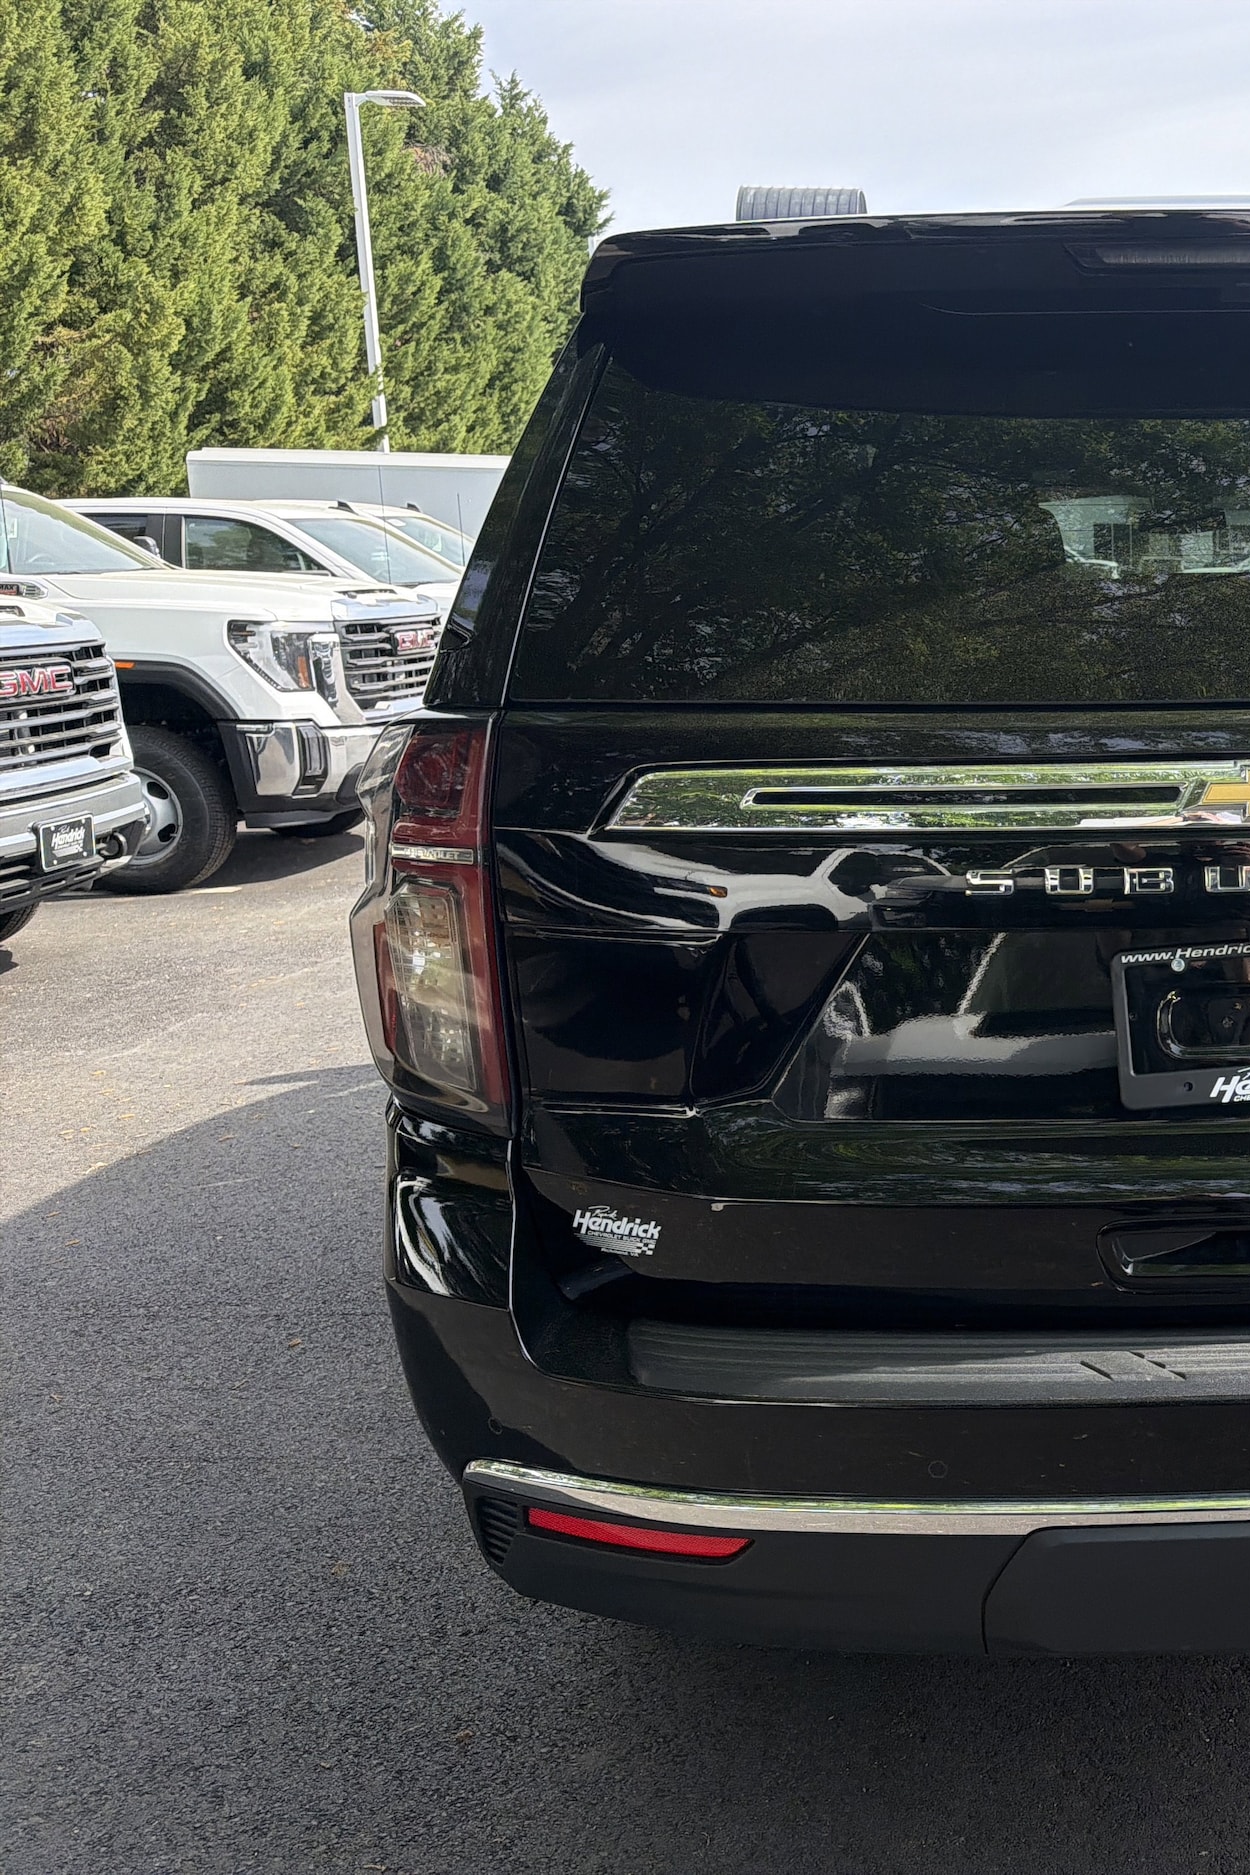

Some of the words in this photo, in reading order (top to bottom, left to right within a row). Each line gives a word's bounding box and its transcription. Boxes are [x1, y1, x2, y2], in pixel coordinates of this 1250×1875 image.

[0, 664, 73, 697] GMC
[51, 826, 85, 850] Hendrick
[572, 1209, 662, 1240] Hendrick
